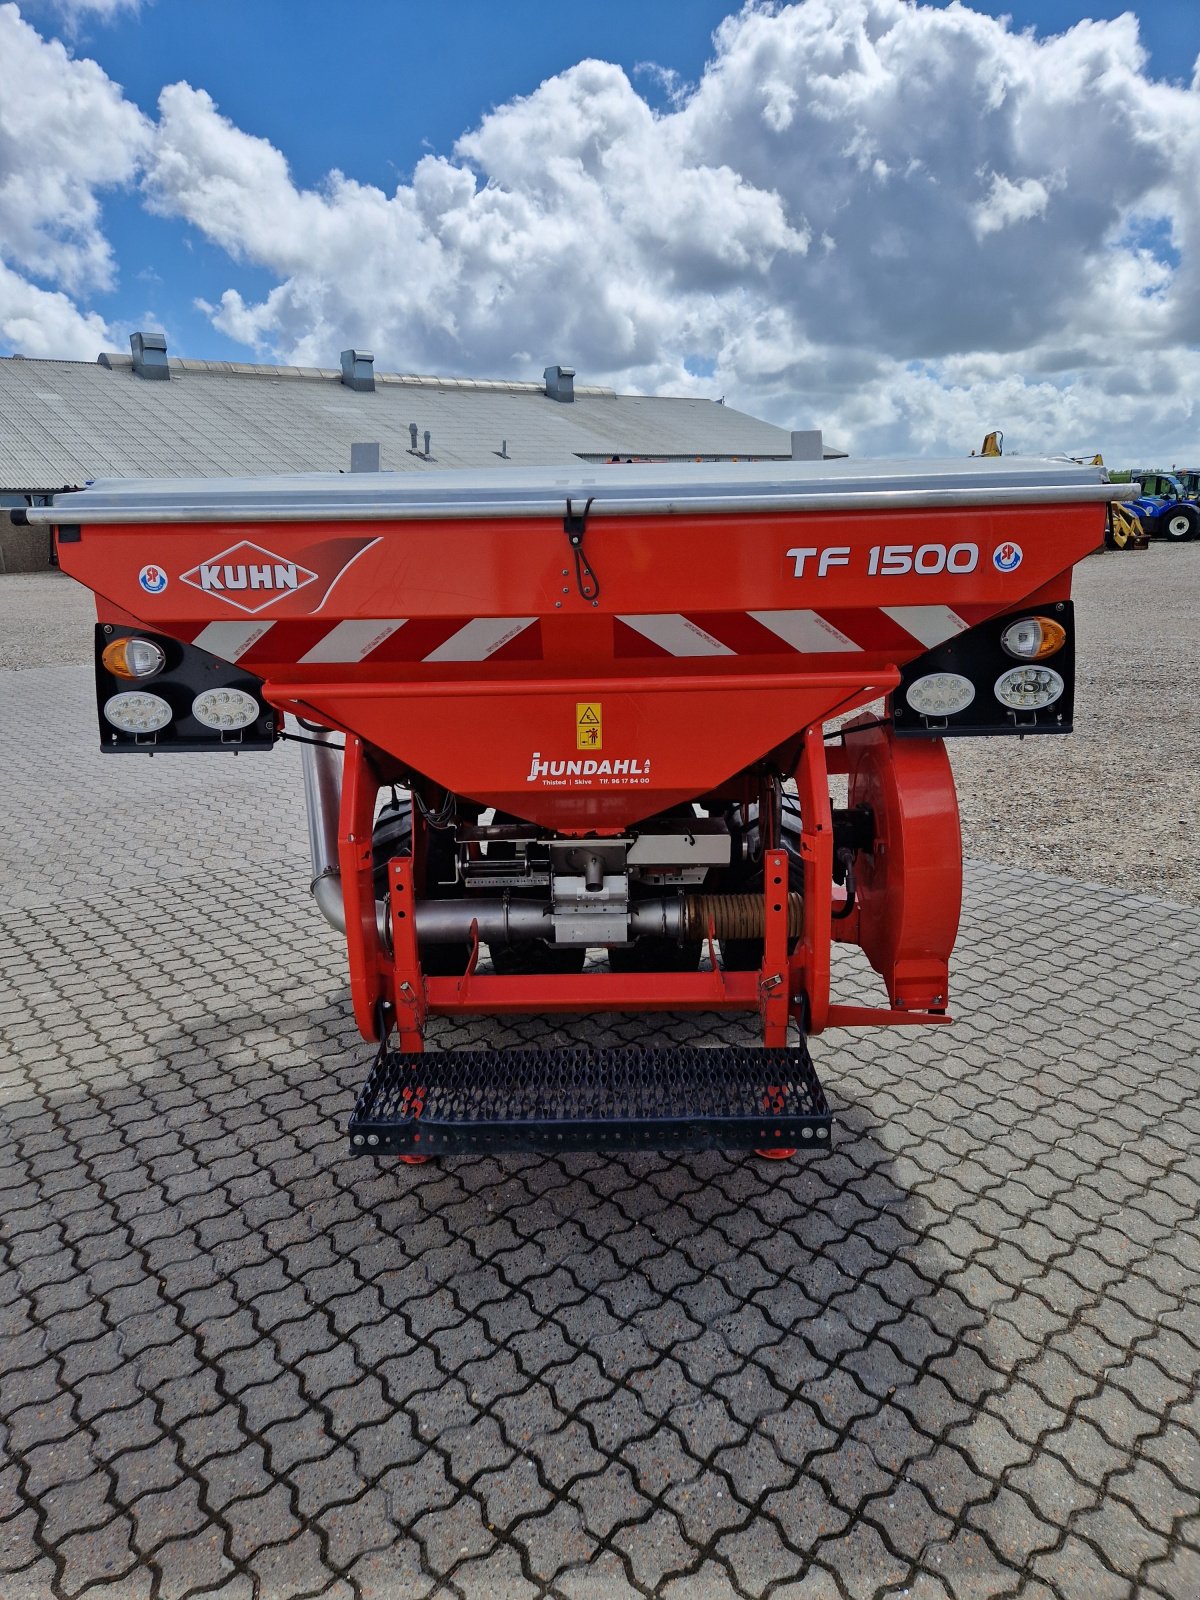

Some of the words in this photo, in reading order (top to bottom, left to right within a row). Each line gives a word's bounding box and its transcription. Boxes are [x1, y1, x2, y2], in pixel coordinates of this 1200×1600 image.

[786, 546, 851, 578] TF
[867, 542, 979, 576] 1500
[1001, 544, 1015, 560] SP
[146, 567, 159, 583] SP
[199, 563, 299, 590] KUHN
